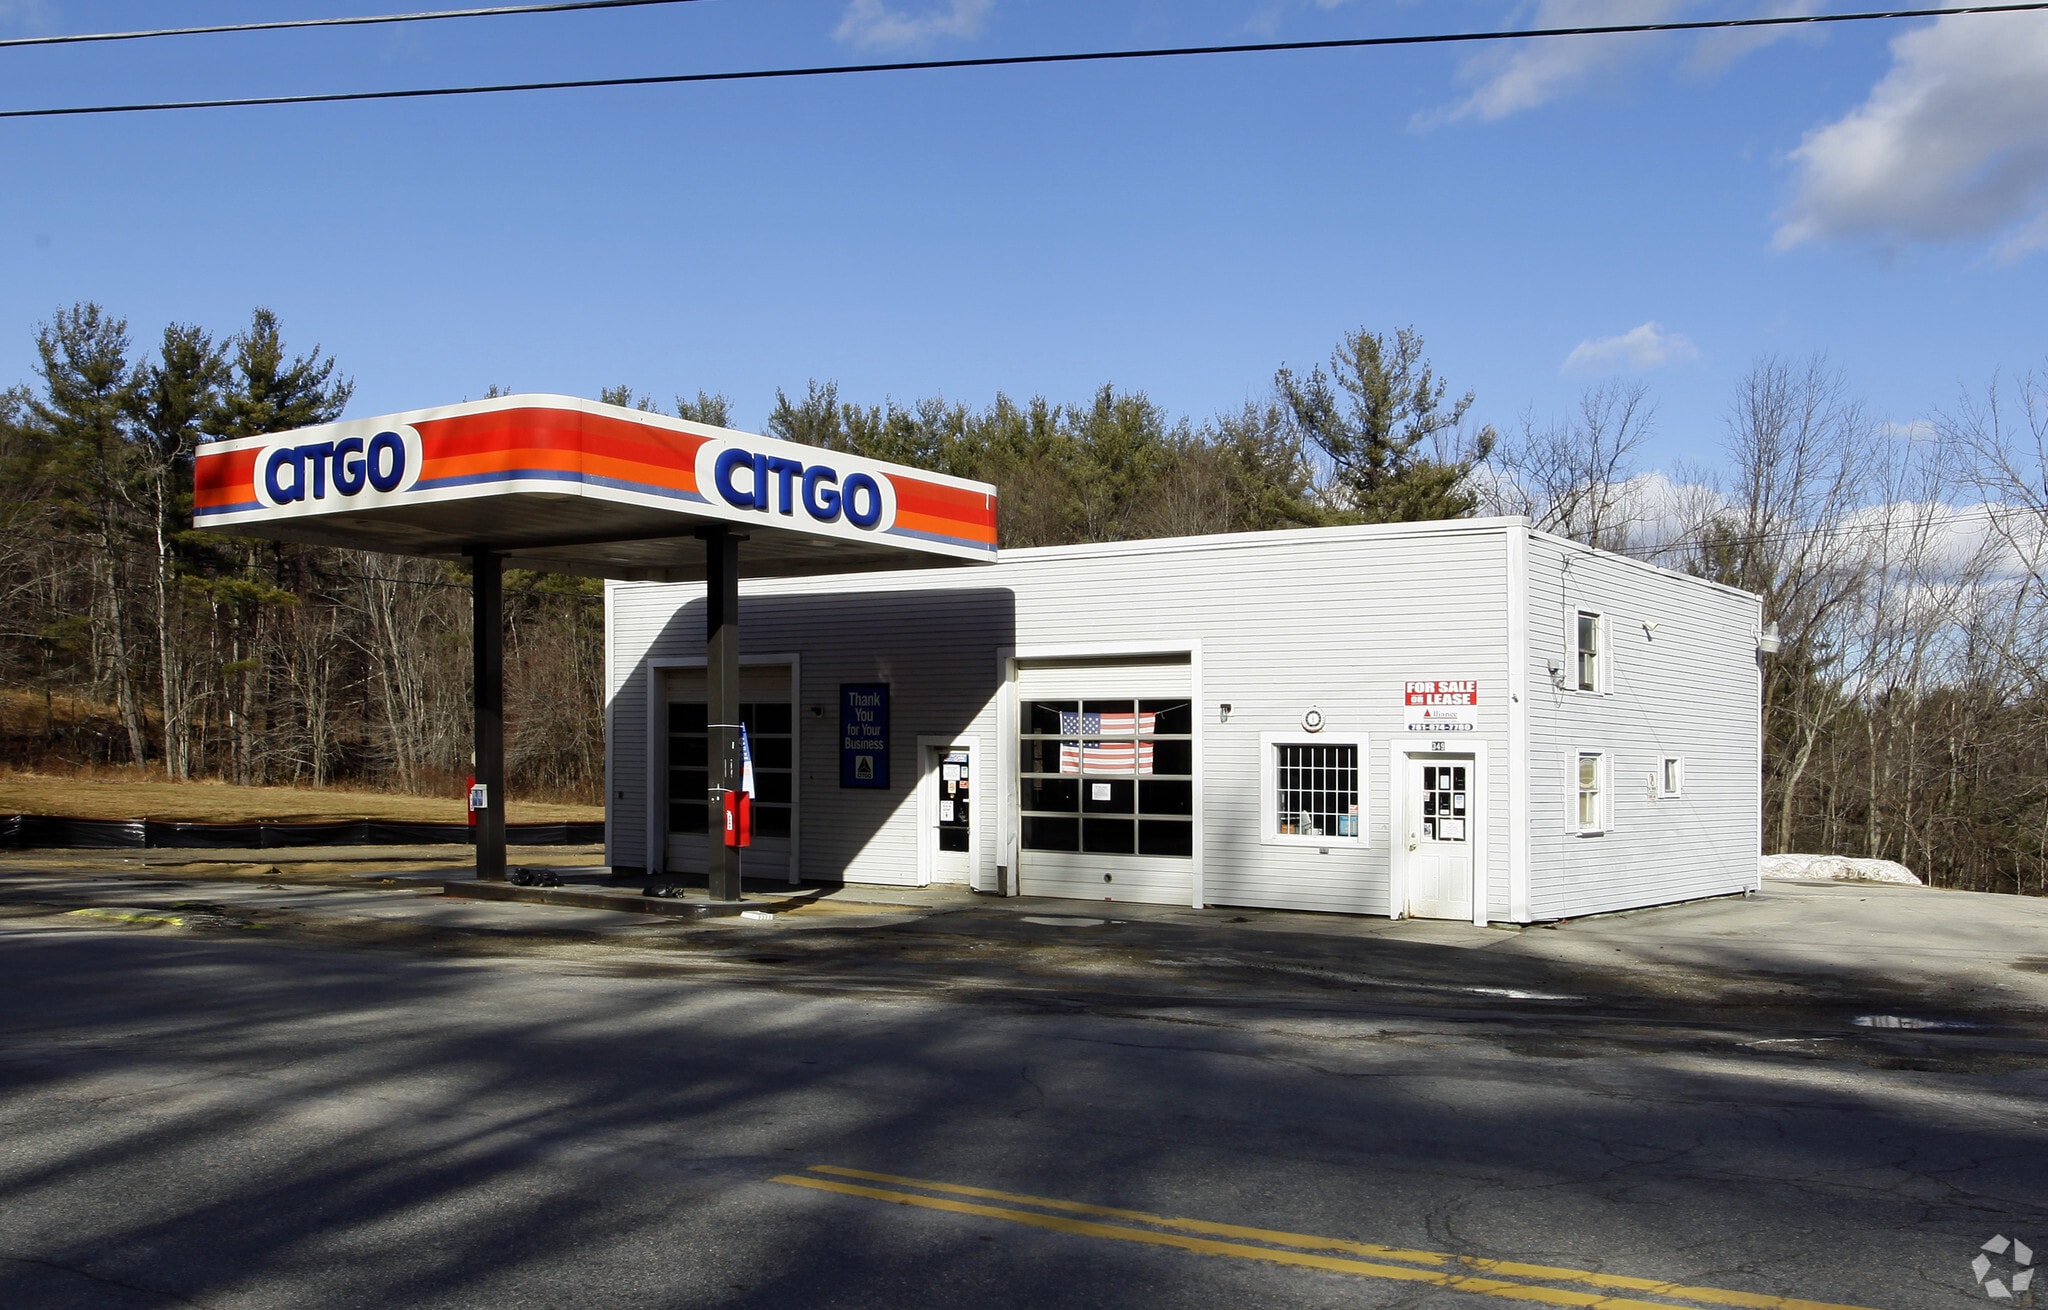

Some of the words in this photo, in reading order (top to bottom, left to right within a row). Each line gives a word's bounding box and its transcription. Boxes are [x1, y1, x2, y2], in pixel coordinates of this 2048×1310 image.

[265, 431, 406, 505] CITGO
[714, 447, 882, 528] CITGO
[1407, 682, 1435, 693] FOR
[1438, 681, 1475, 693] SALE
[848, 692, 880, 706] Thank
[1427, 693, 1471, 705] LEASE
[855, 708, 873, 722] You
[847, 723, 859, 736] for
[861, 723, 881, 736] Your
[845, 737, 884, 750] Business
